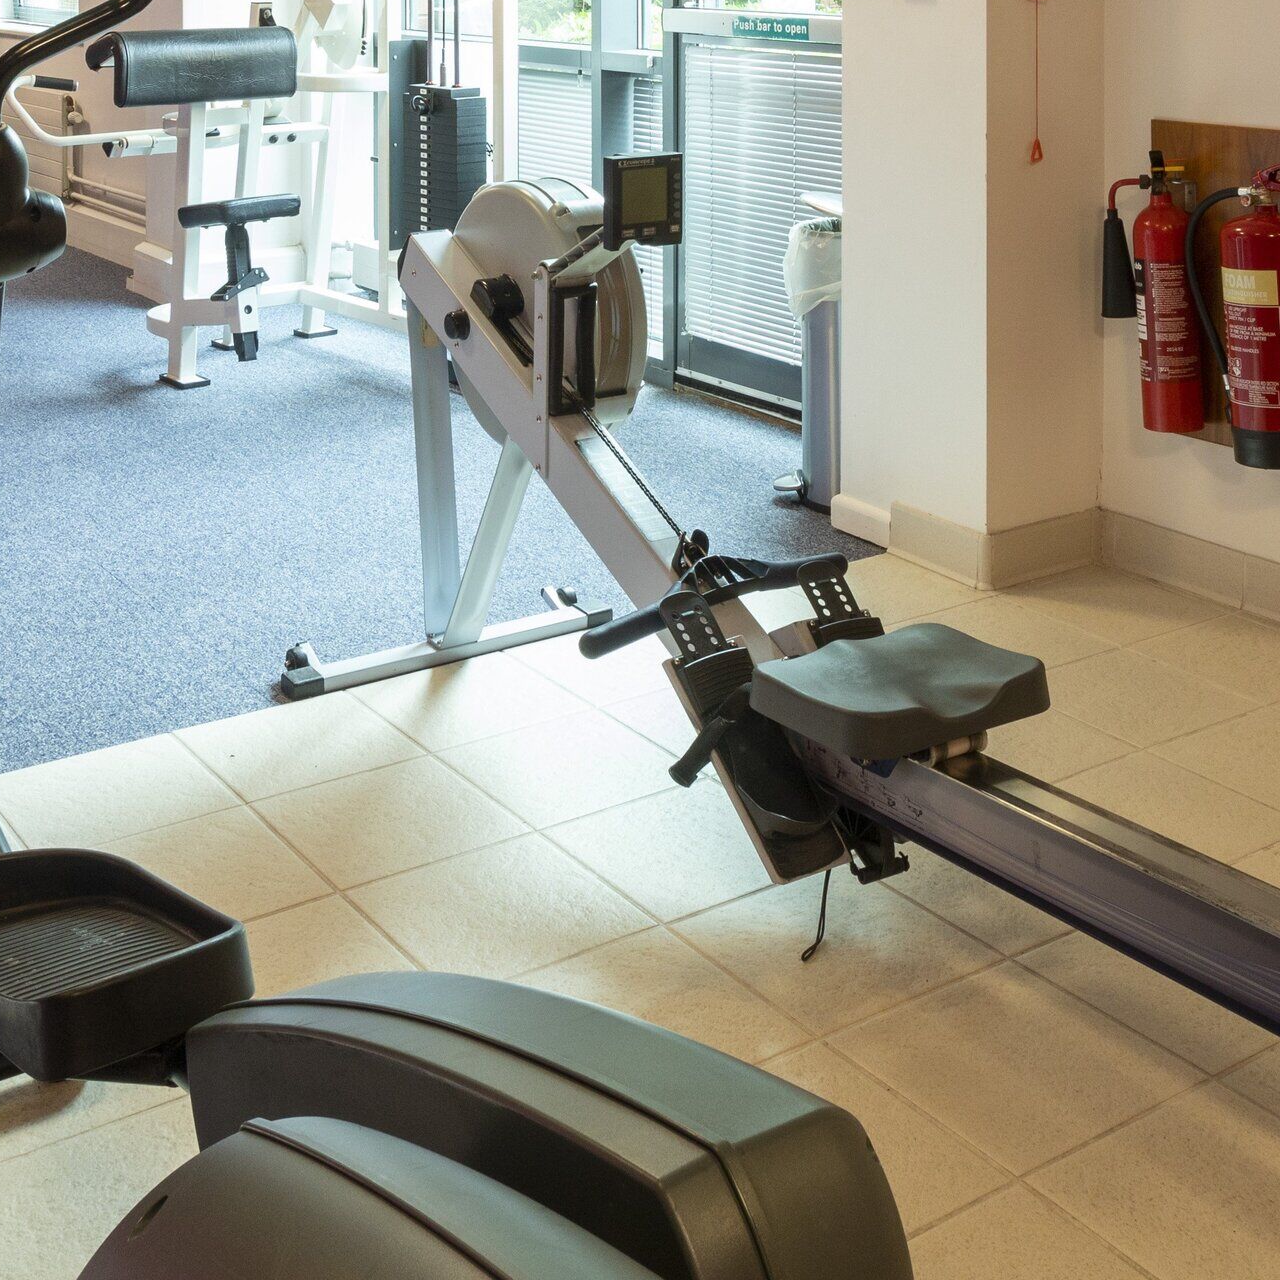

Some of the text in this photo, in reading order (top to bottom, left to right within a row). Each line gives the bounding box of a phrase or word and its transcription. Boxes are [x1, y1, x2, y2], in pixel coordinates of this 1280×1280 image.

[733, 18, 807, 36] Push bar to open
